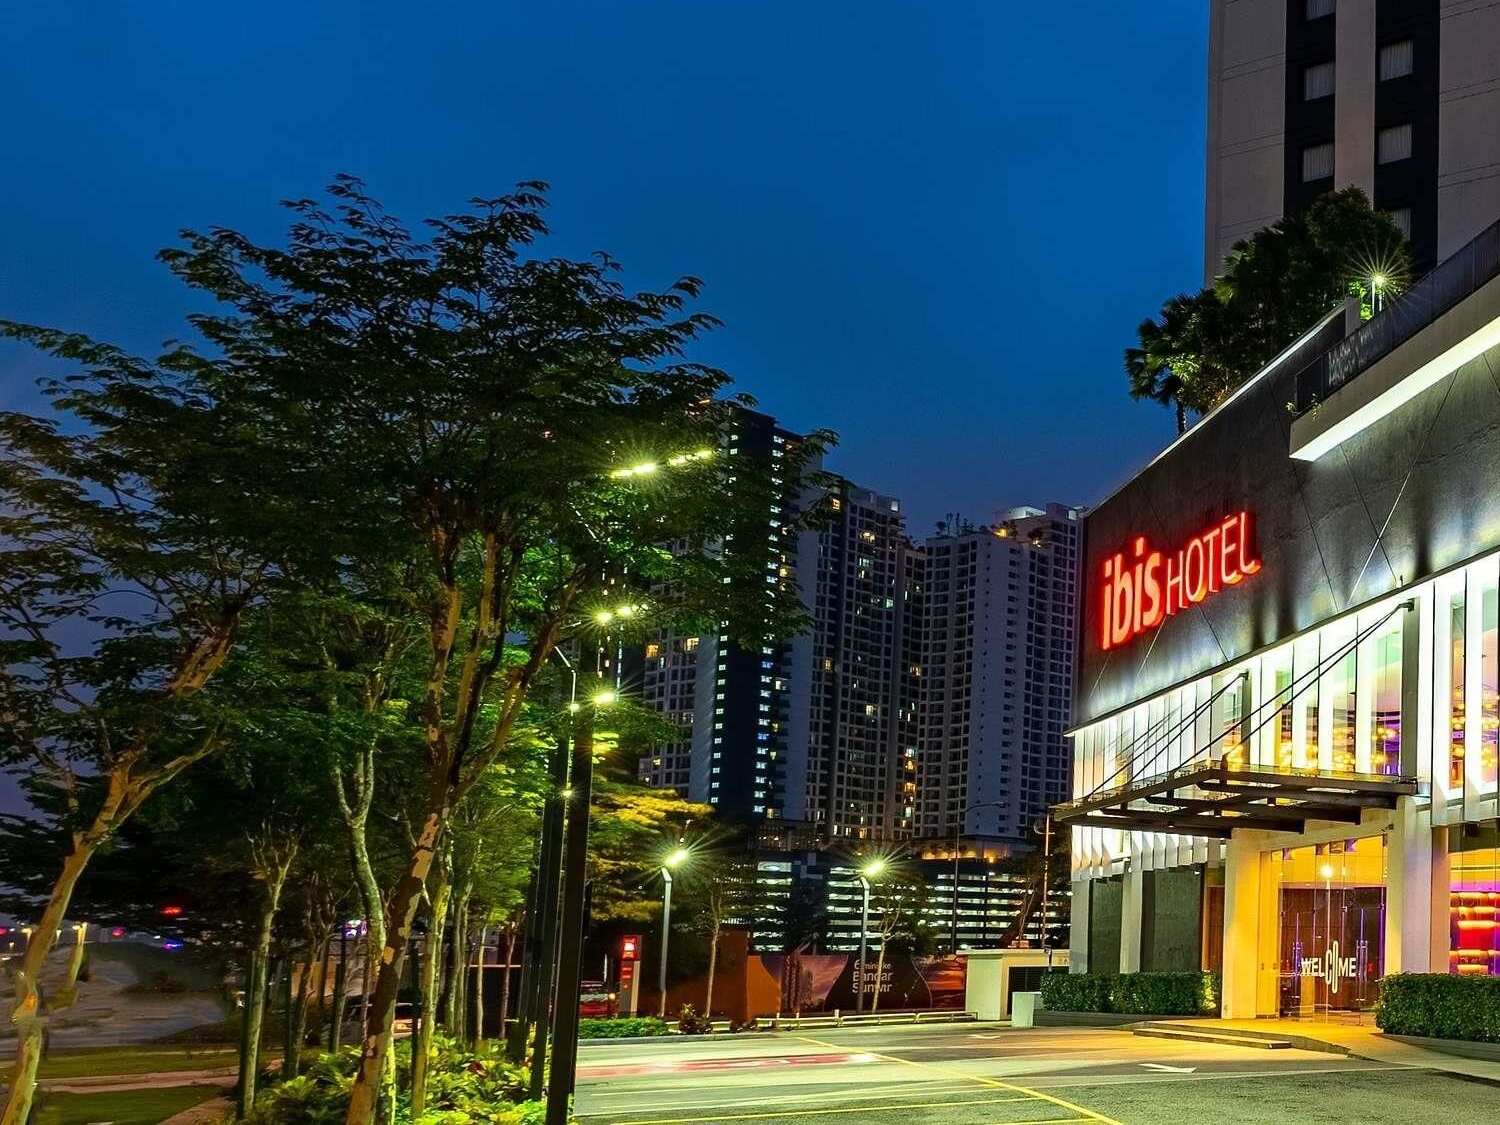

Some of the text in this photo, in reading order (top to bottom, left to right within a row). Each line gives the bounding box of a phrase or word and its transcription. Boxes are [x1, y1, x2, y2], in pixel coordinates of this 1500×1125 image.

[1101, 511, 1262, 650] ibis HOTEL
[1300, 940, 1357, 994] WELCOME
